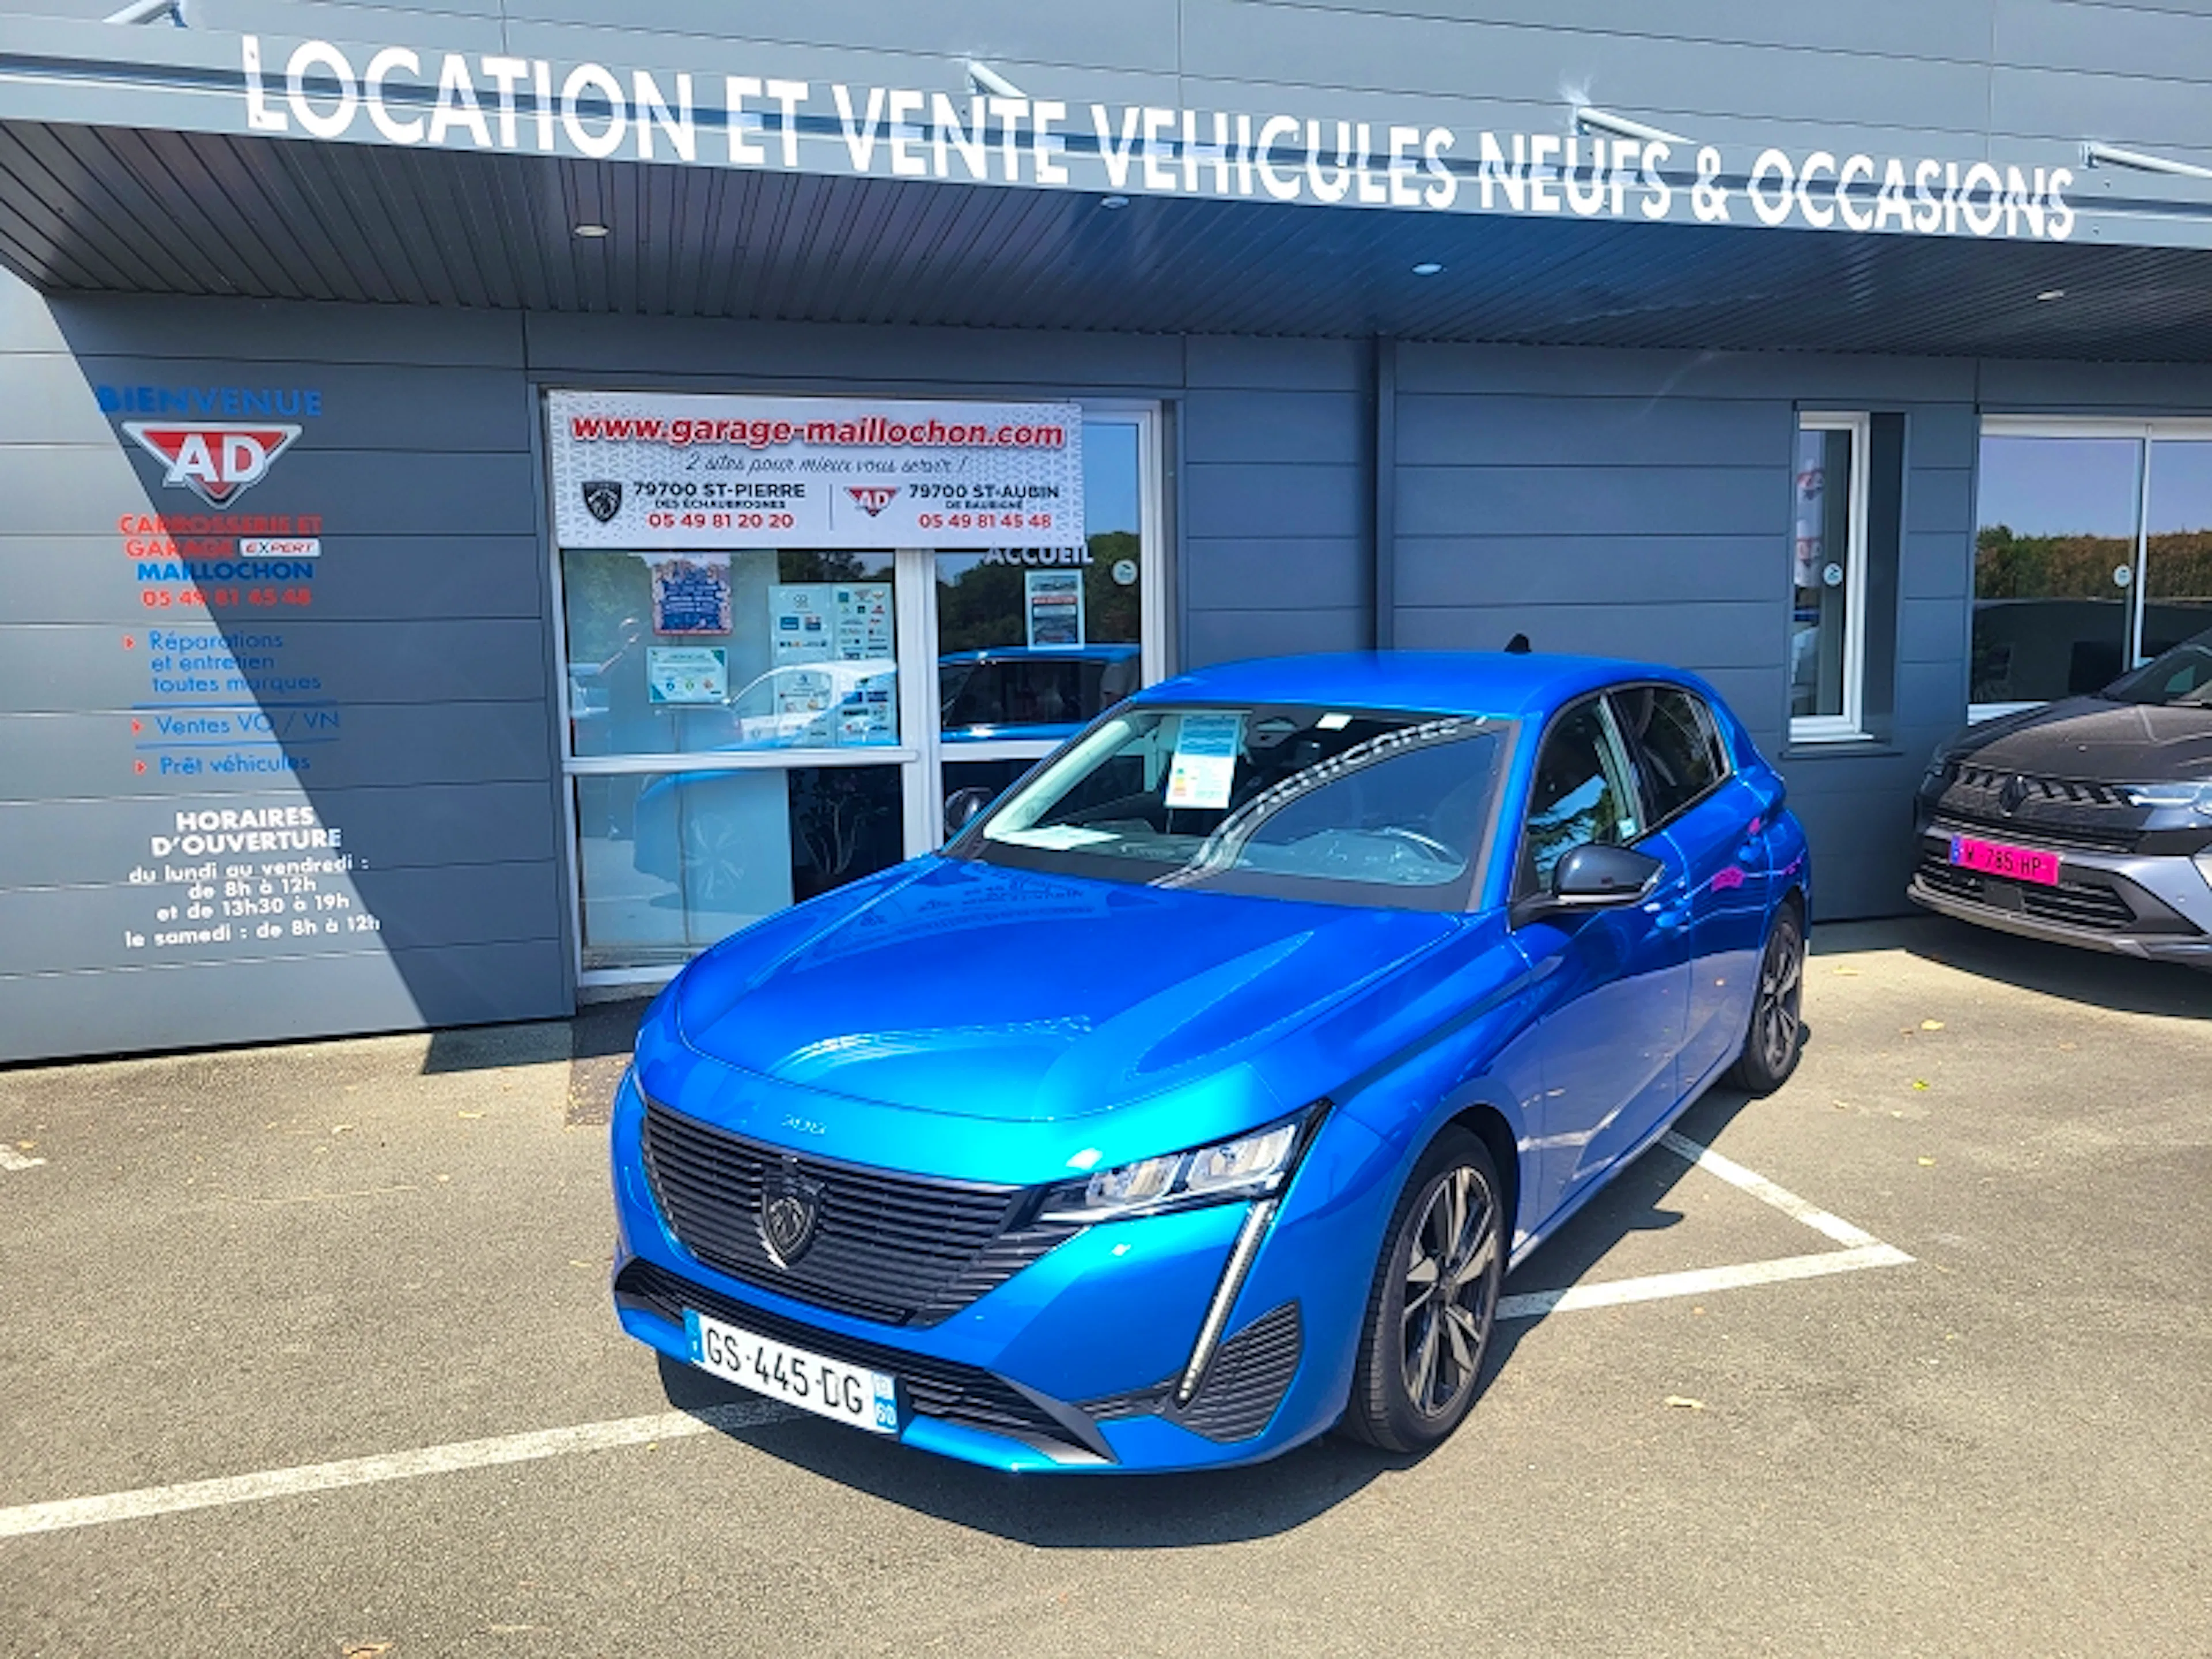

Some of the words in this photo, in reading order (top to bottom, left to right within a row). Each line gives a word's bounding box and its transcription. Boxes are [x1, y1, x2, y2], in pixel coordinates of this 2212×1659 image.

[241, 35, 695, 161] LOCATION
[725, 75, 808, 166] ET
[832, 85, 1069, 184] VENTE
[1091, 104, 1456, 209] VEHICULES
[1479, 131, 1671, 219] NEUFS
[1691, 146, 1728, 222] &
[1747, 149, 2073, 240] OCCASIONS
[97, 385, 323, 416] BIENVENUE
[572, 414, 1066, 449] www.garage-maillochon.com
[166, 433, 267, 482] AD
[686, 453, 699, 470] 2
[634, 482, 697, 496] 79700
[703, 483, 805, 498] ST-PIERRE
[909, 484, 968, 498] 79700
[972, 484, 1059, 499] ST-AUBIN
[656, 500, 679, 509] DES
[119, 514, 292, 535] CARROSSERIE
[297, 514, 323, 535] ET
[649, 513, 675, 528] 05
[680, 513, 706, 528] 49
[713, 513, 731, 528] 81
[738, 513, 763, 529] 20
[768, 513, 794, 529] 20
[920, 513, 943, 528] 05
[948, 513, 971, 529] 49
[979, 514, 995, 529] 81
[1001, 514, 1024, 529] 45
[1028, 514, 1051, 529] 48
[125, 538, 234, 559] GARAGE
[245, 541, 316, 554] EXPERT
[983, 543, 1094, 566] ACCUEIL
[138, 562, 313, 581] MAILLOCHON
[142, 588, 172, 608] 05
[176, 588, 208, 607] 49
[148, 630, 284, 653] Réparations
[150, 656, 172, 672] et
[179, 653, 275, 671] entretien
[152, 676, 219, 694] toutes
[226, 676, 322, 694] marques
[154, 715, 230, 735] Ventes
[237, 713, 274, 733] VO
[304, 710, 340, 729] VN
[160, 756, 203, 775] Prêt
[210, 752, 311, 773] véhicules
[175, 806, 314, 832] HORAIRES
[150, 828, 343, 857] D'OUVERTURE
[128, 866, 156, 884] du
[165, 862, 217, 882] lundi
[225, 865, 253, 879] au
[261, 855, 353, 876] vendredi
[187, 883, 215, 901] de
[225, 879, 252, 897] 8h
[281, 876, 317, 894] 12h
[156, 905, 178, 922] et
[187, 902, 214, 921] de
[222, 897, 285, 917] 13h30
[315, 893, 350, 910] 19h
[125, 930, 145, 948] le
[154, 925, 232, 946] samedi
[256, 922, 283, 940] de
[291, 918, 318, 936] 8h
[347, 914, 381, 933] 12h
